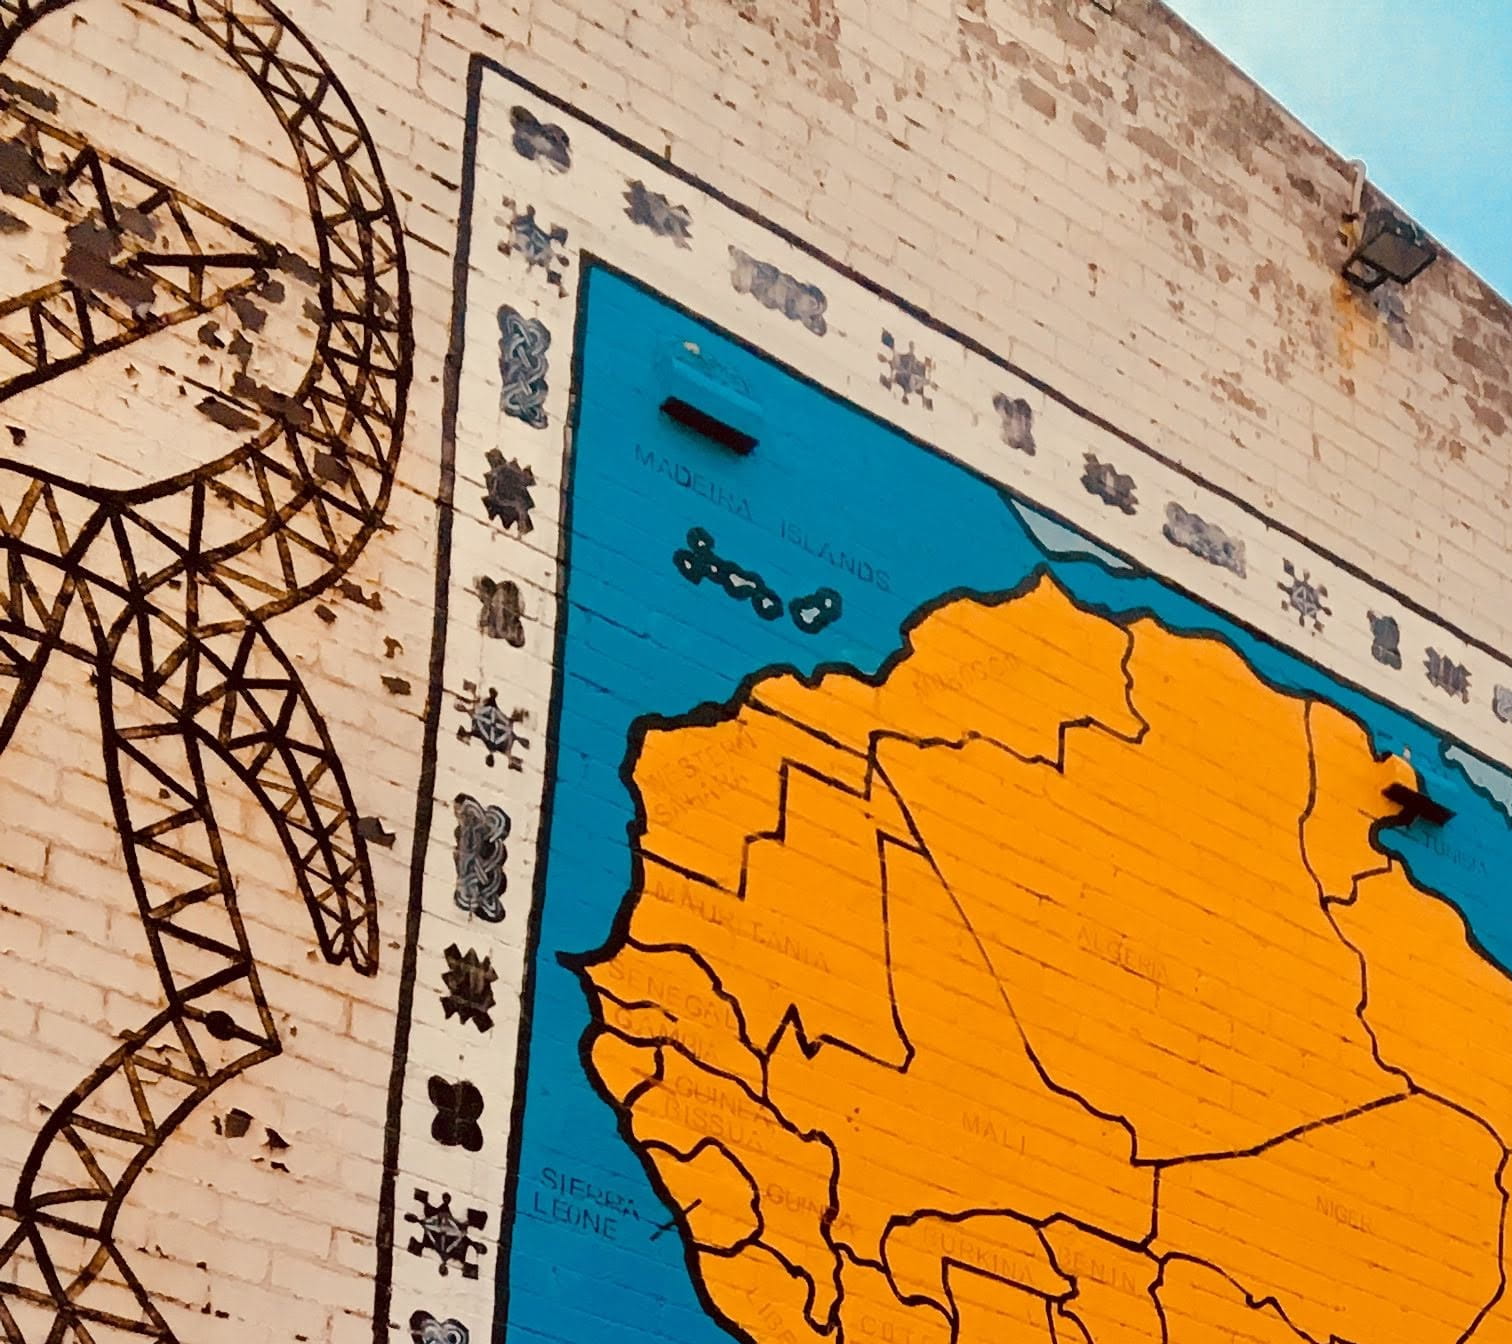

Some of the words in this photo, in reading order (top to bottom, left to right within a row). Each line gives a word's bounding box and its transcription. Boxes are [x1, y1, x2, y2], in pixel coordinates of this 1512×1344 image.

[634, 443, 753, 521] MADEIRA
[780, 518, 893, 593] ISLANDS
[961, 1110, 1028, 1158] MALI
[533, 1190, 617, 1241] LEONE
[540, 1166, 640, 1221] SIERRA
[921, 1223, 1036, 1284] BURKINA
[1057, 1245, 1136, 1292] BENIN
